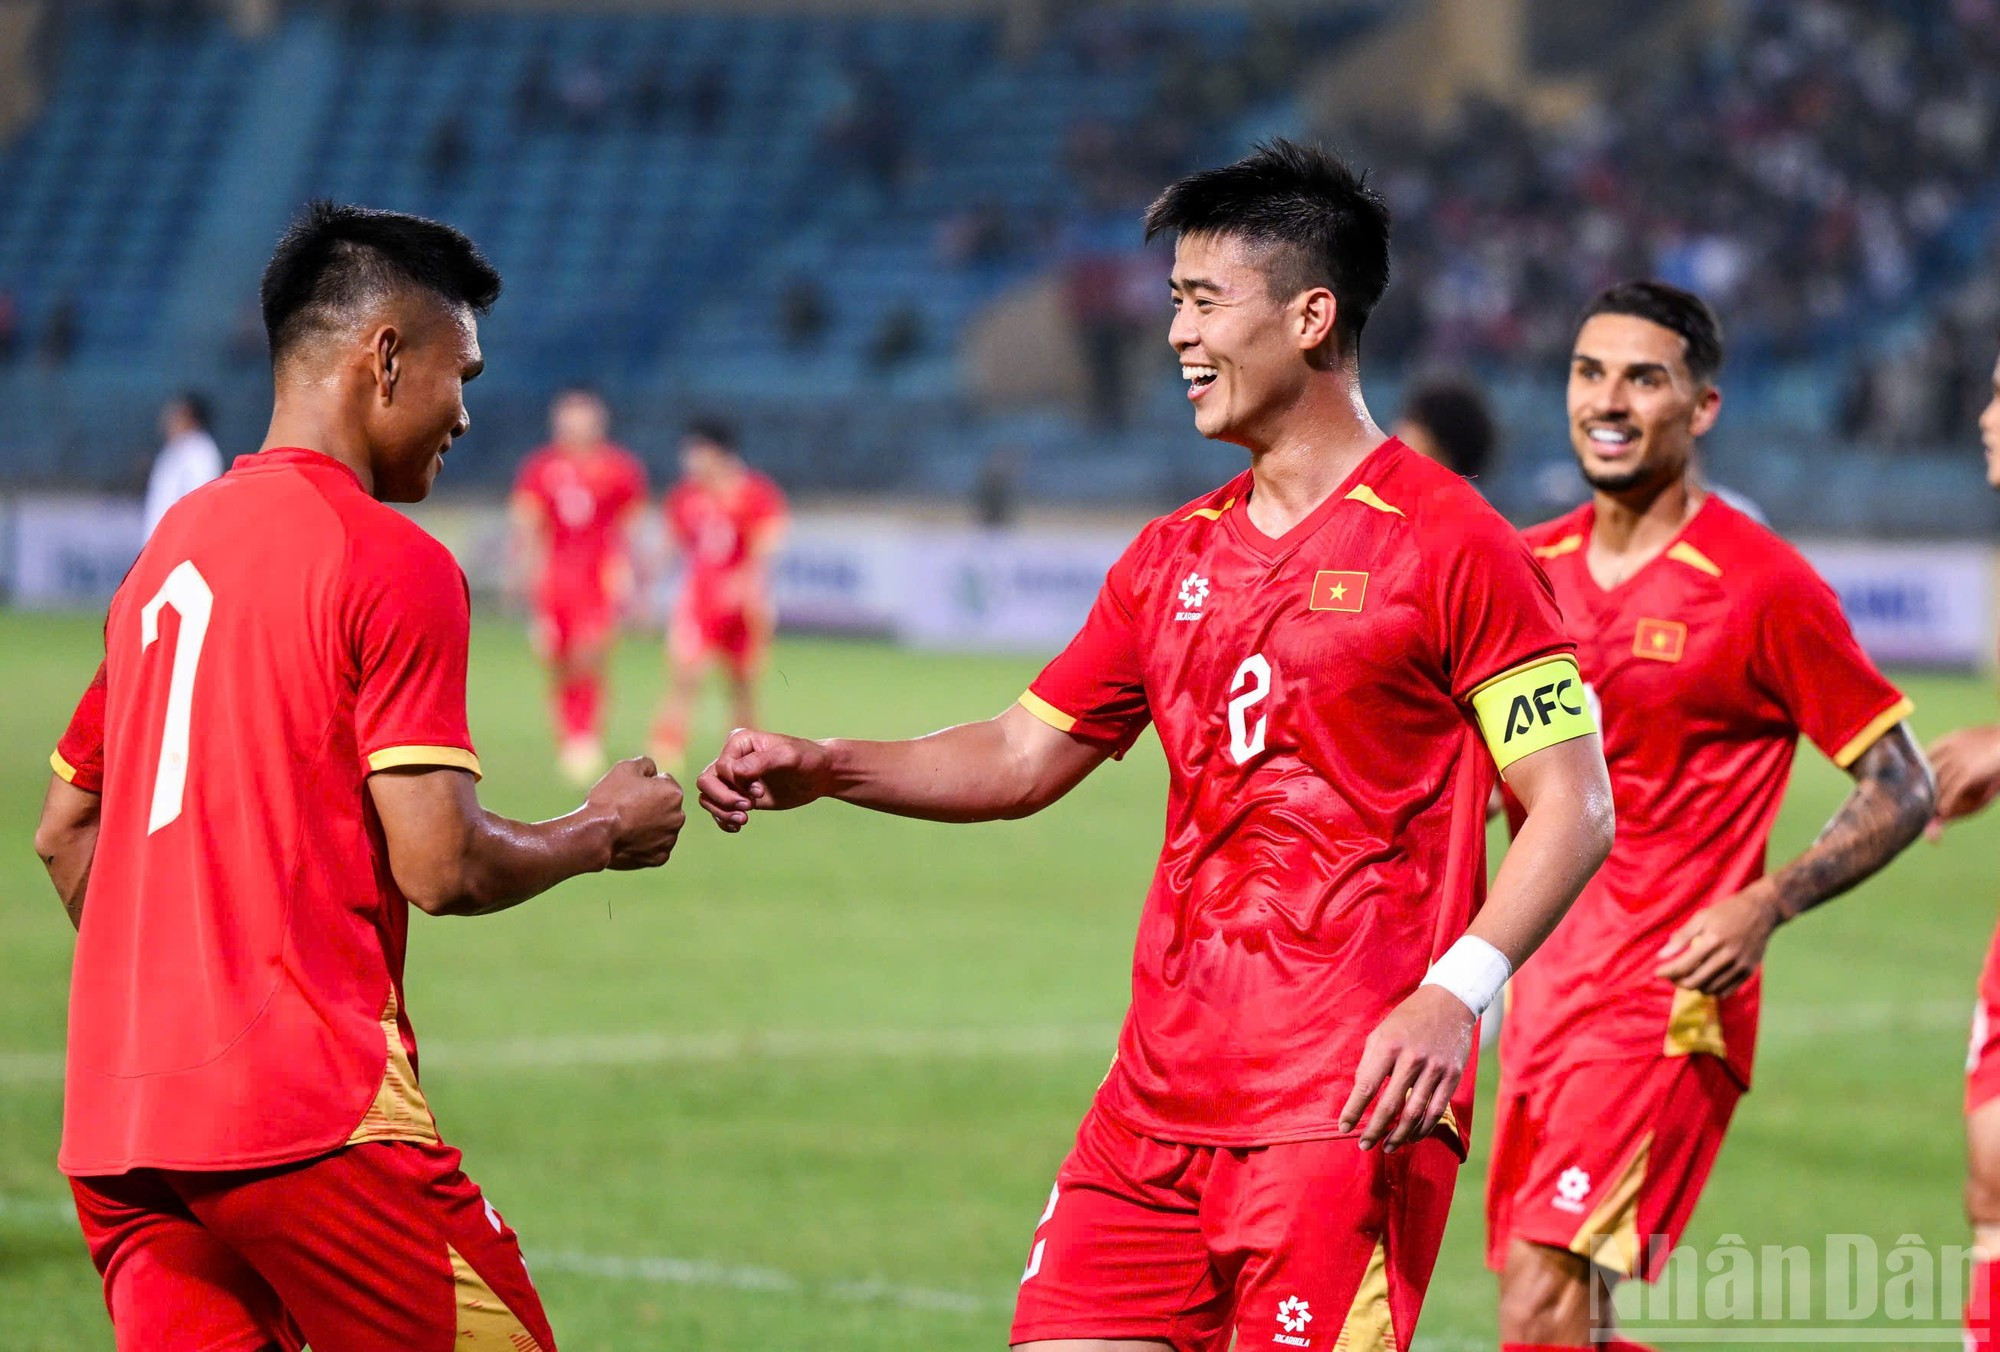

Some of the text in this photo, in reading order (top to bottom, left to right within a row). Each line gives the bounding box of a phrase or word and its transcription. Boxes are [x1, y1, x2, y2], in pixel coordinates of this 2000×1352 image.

[141, 559, 214, 837] 7
[1227, 652, 1272, 766] 2
[1504, 678, 1582, 744] AFC
